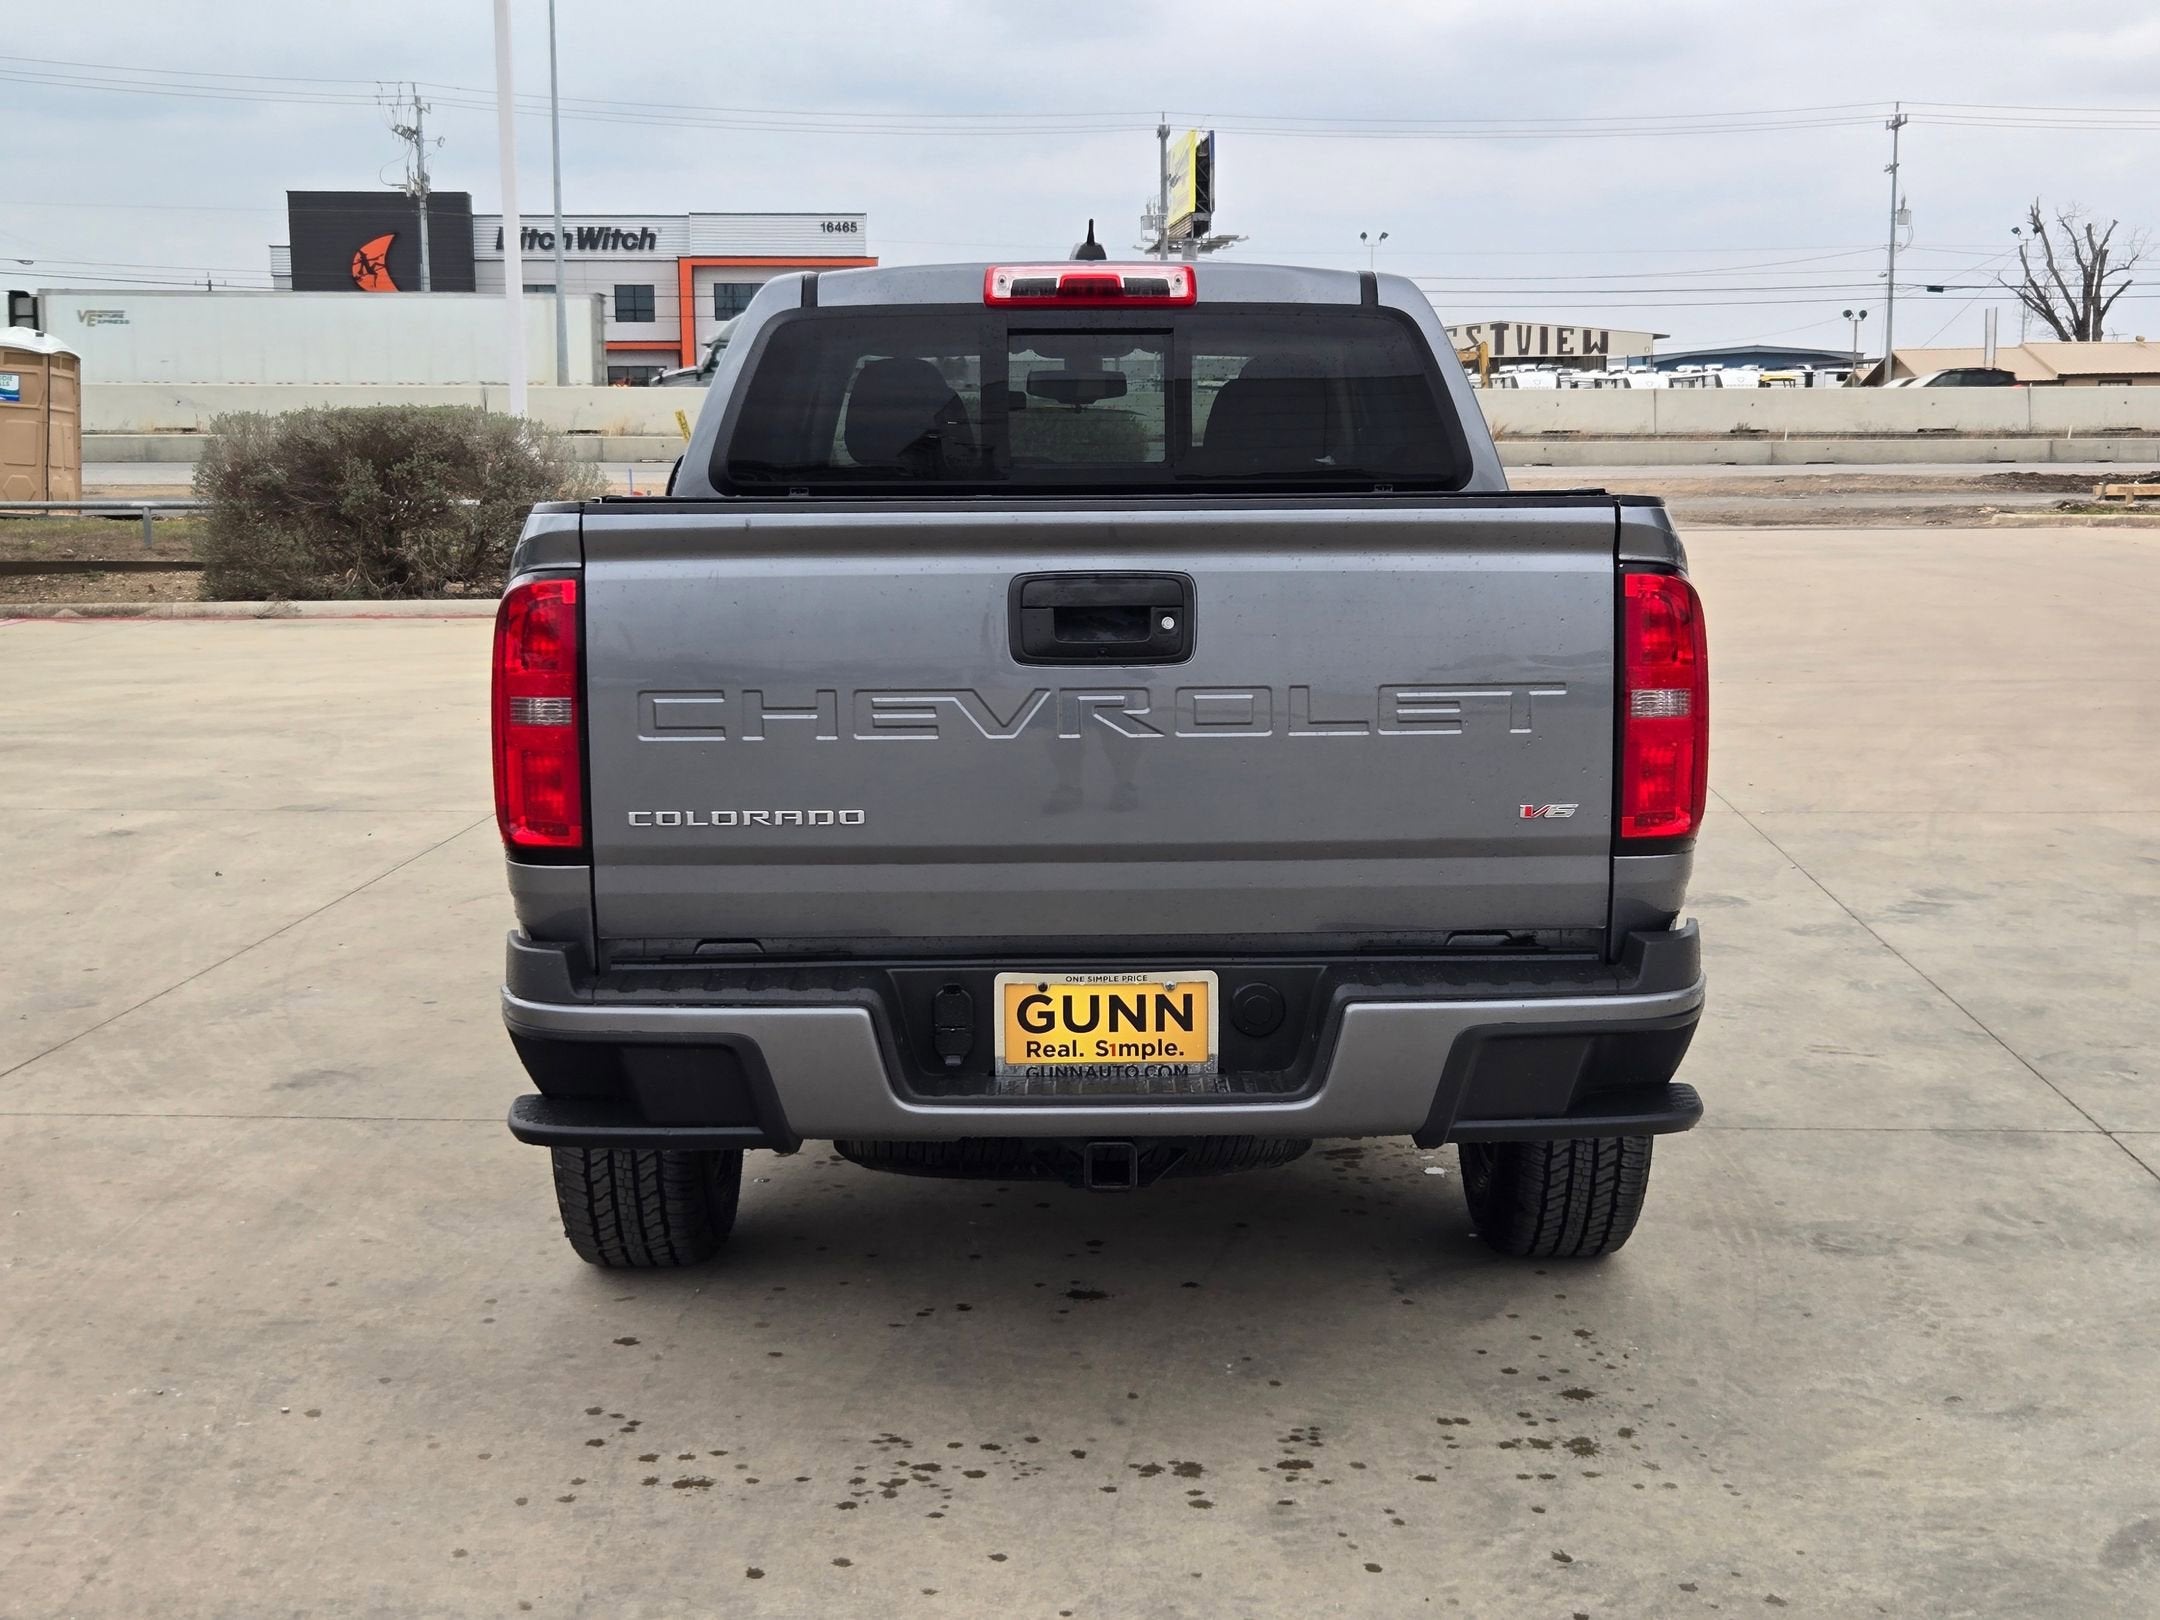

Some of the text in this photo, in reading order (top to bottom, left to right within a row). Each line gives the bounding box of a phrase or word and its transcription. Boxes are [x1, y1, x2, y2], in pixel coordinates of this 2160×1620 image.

[820, 221, 858, 233] 16465
[1446, 322, 1609, 356] STVIEW
[637, 682, 1567, 742] CHEVROLET
[627, 809, 866, 827] COLORADO
[1519, 803, 1579, 818] V6
[1065, 974, 1148, 983] ONE SIMPLE PRICE
[1016, 993, 1194, 1034] GUNN
[1026, 1040, 1084, 1058] Real.
